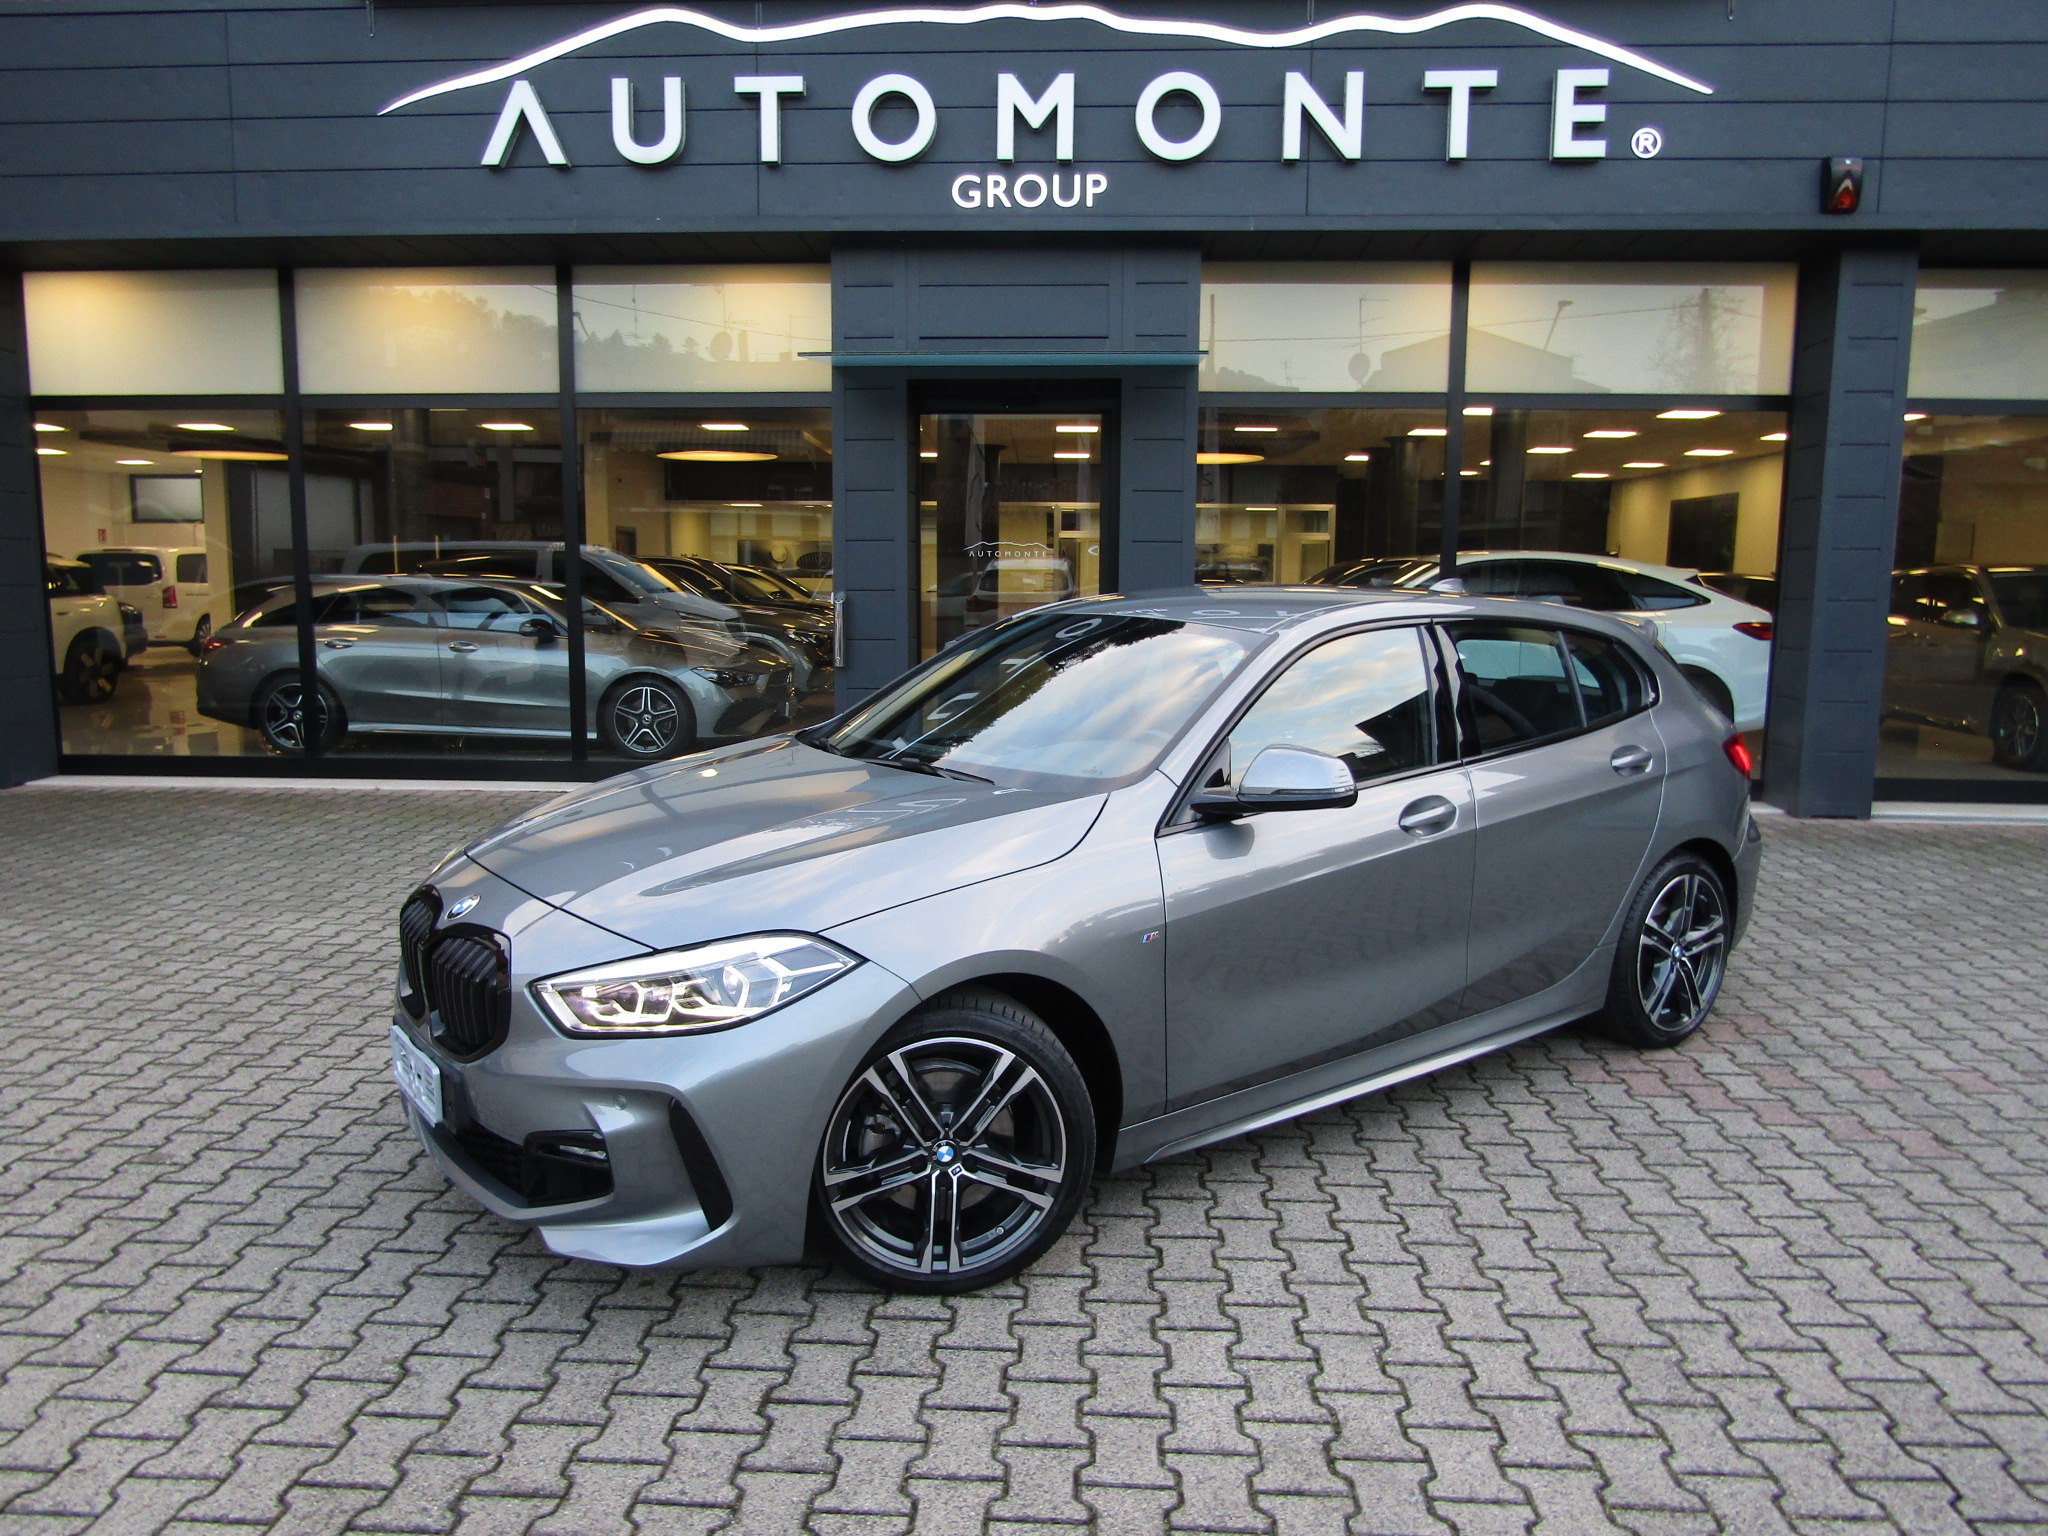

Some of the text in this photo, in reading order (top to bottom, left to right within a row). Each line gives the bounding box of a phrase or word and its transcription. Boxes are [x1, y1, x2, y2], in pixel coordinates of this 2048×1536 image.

[481, 68, 1609, 167] AUTOMONTE
[951, 173, 1108, 209] GROUP
[968, 550, 1047, 558] AUTOMONTE
